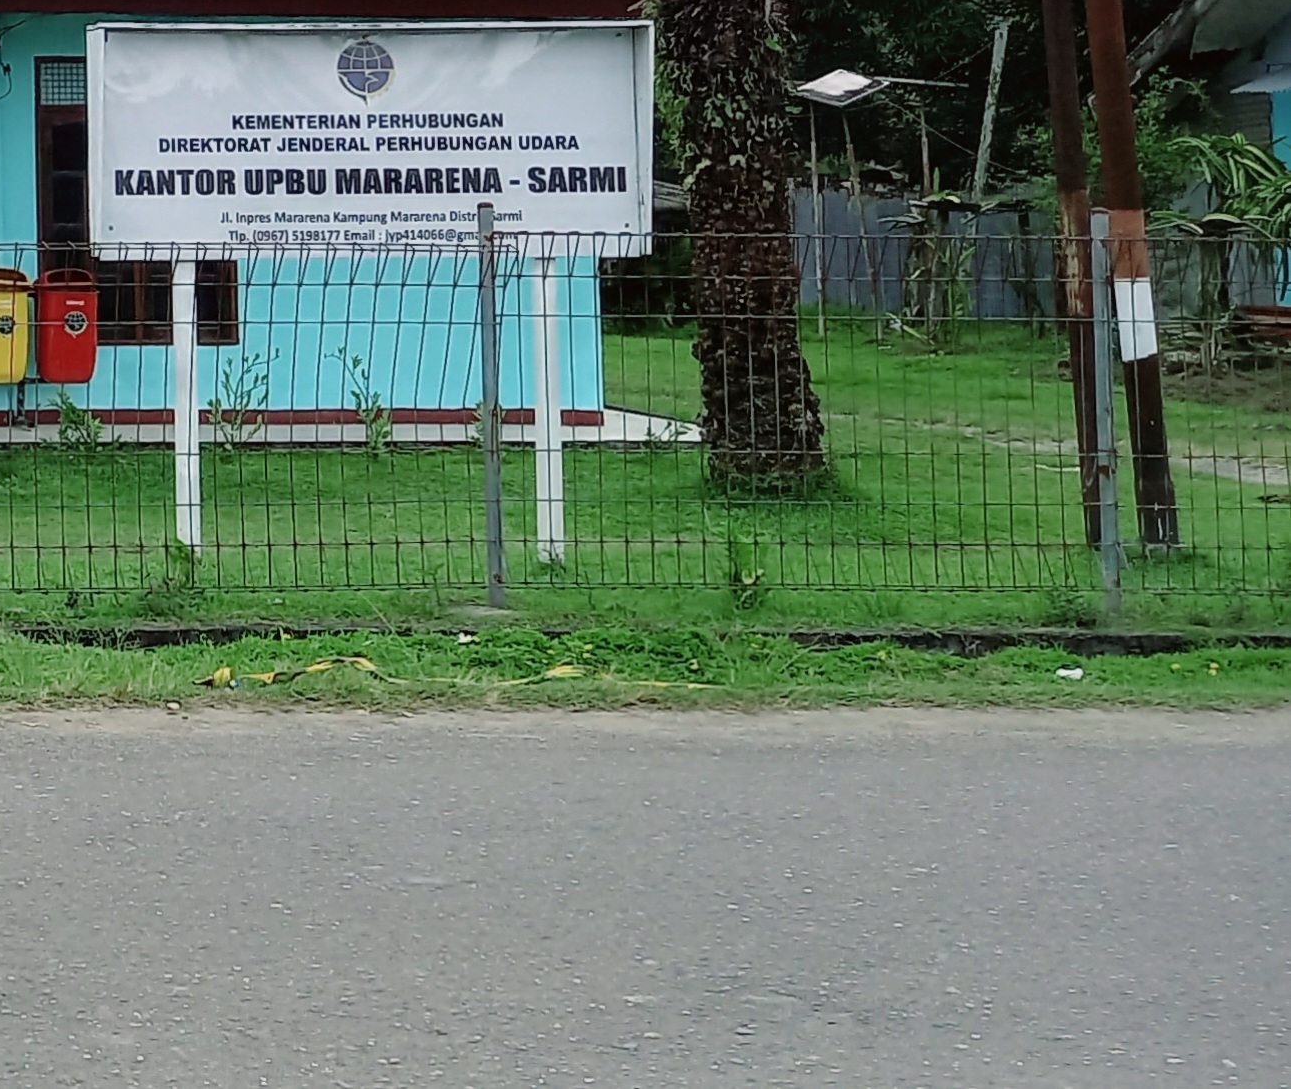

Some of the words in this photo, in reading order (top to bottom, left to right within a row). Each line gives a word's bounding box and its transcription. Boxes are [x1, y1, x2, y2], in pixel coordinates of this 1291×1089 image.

[232, 114, 361, 130] KEMENTERIAN
[366, 113, 504, 129] PERHUBUNGAN
[159, 138, 271, 153] DIREKTORAT
[277, 137, 370, 152] JENDERAL
[376, 136, 512, 151] PERHUBUNGAN
[519, 135, 579, 150] UDARA
[115, 169, 236, 195] KANTOR
[244, 168, 327, 195] UPBU
[335, 168, 502, 195] MARARENA
[528, 166, 626, 193] SARMI
[220, 212, 233, 223] Jl.
[236, 212, 271, 225] Inpres
[274, 212, 330, 223] Mararena
[334, 211, 387, 225] Kampung
[391, 211, 446, 222] Mararena
[228, 230, 250, 243] Tlp.
[252, 229, 289, 243] (0967)
[292, 230, 341, 241] 5198177
[344, 229, 375, 241] Email
